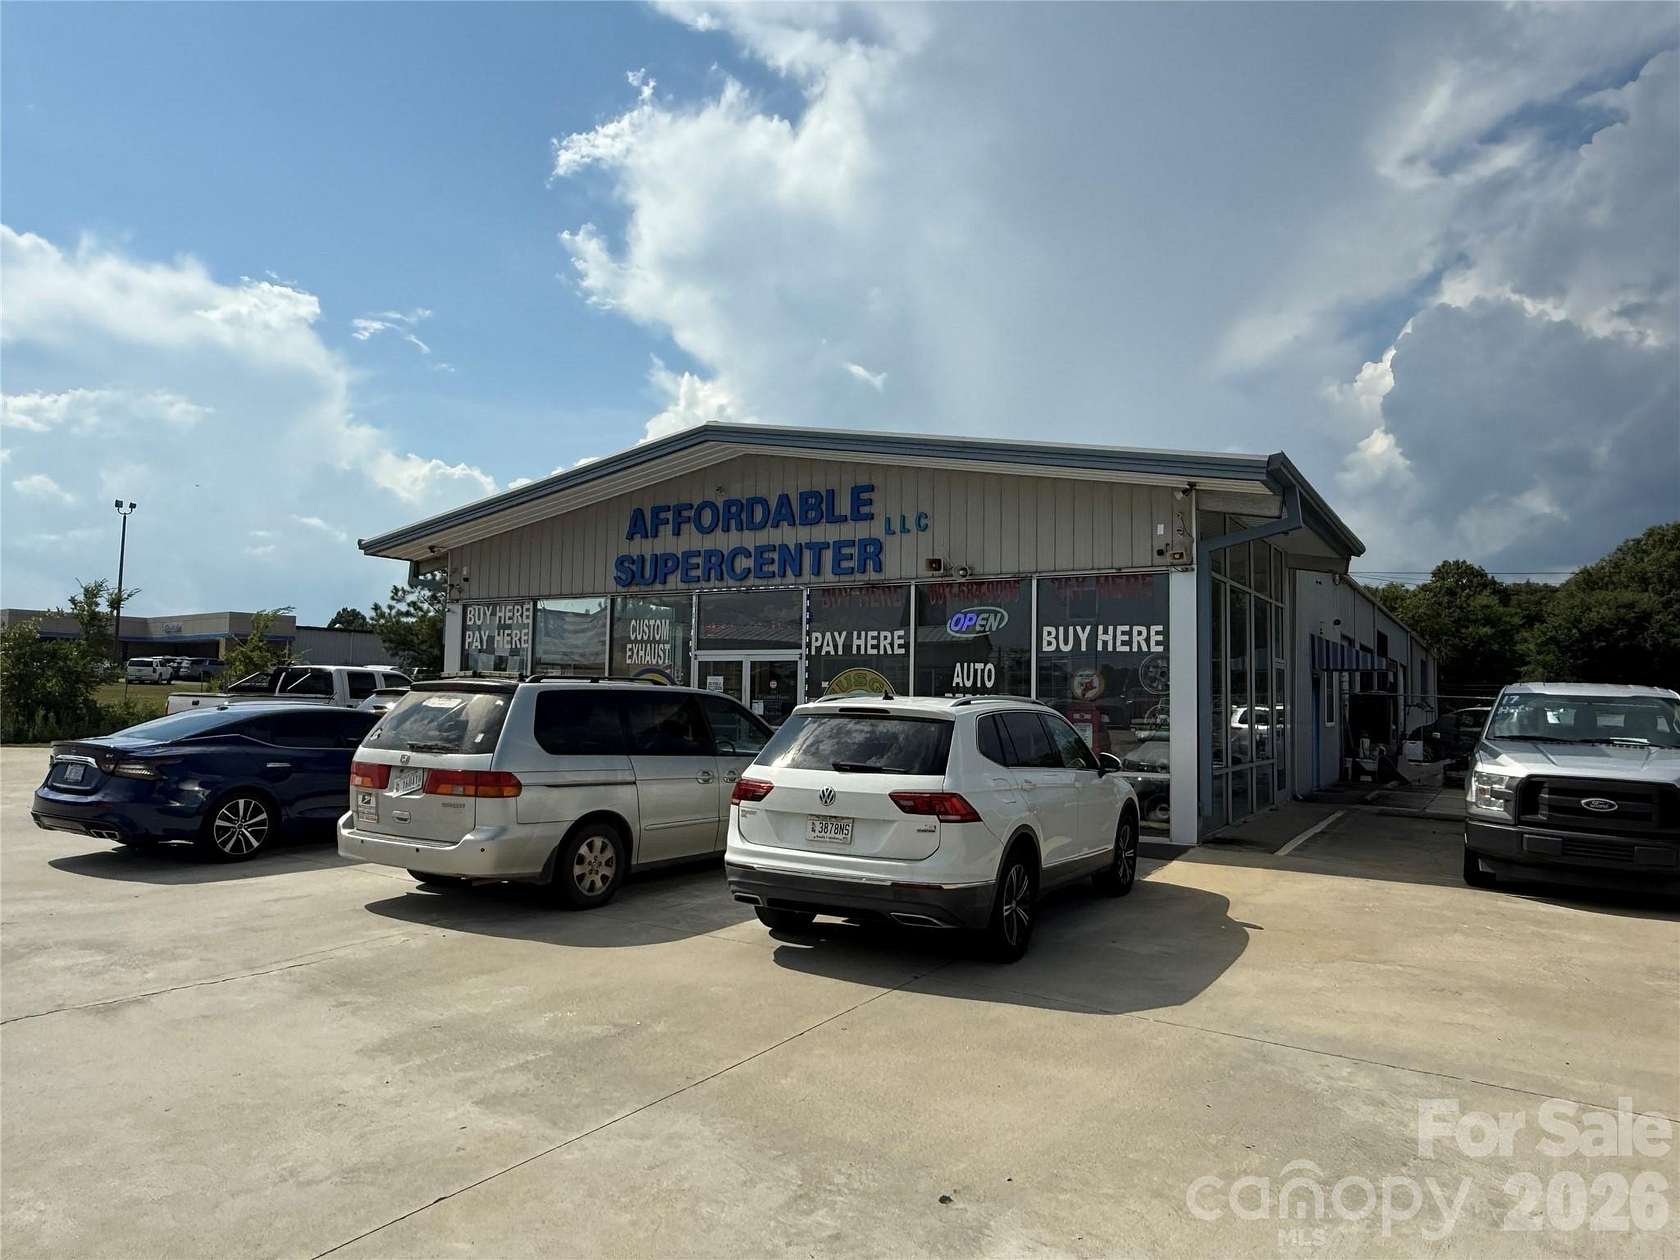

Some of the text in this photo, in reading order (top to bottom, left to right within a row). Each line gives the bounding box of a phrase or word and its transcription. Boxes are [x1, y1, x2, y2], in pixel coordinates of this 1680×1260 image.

[625, 483, 874, 540] AFFORDABLE
[613, 537, 882, 587] SUPERCENTER
[466, 603, 531, 626] BUY HERE
[950, 612, 1002, 633] OPEN
[465, 629, 529, 650] PAY HERE
[629, 618, 670, 641] CUSTOM
[1042, 624, 1164, 652] BUY HERE
[811, 629, 906, 656] PAY HERE
[625, 643, 672, 666] EXHAUST
[952, 662, 996, 688] AUTO
[818, 821, 850, 837] 3878NS
